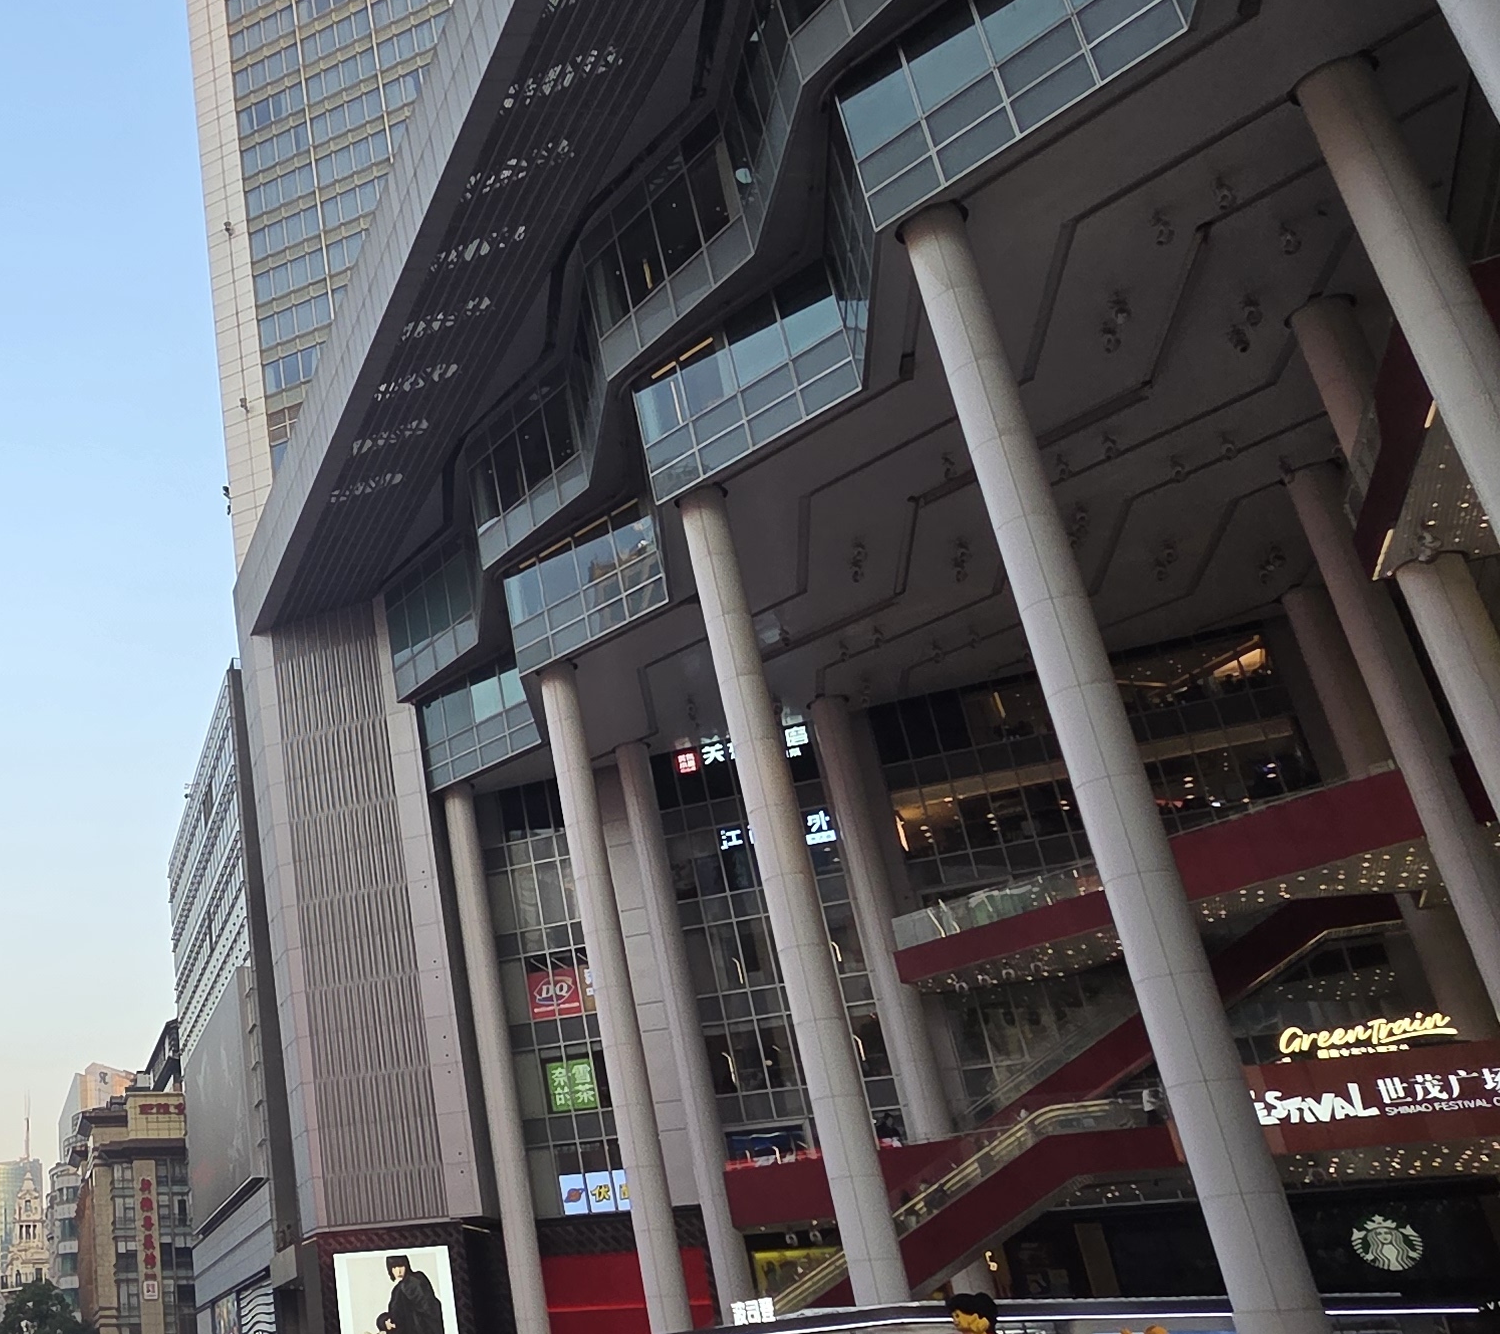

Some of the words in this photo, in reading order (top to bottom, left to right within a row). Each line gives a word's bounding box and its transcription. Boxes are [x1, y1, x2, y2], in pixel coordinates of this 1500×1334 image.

[541, 981, 569, 999] DQ
[1250, 1083, 1381, 1126] ESTIVAL
[1385, 1103, 1433, 1116] SHIMAO
[1433, 1098, 1492, 1112] FESTIVAL
